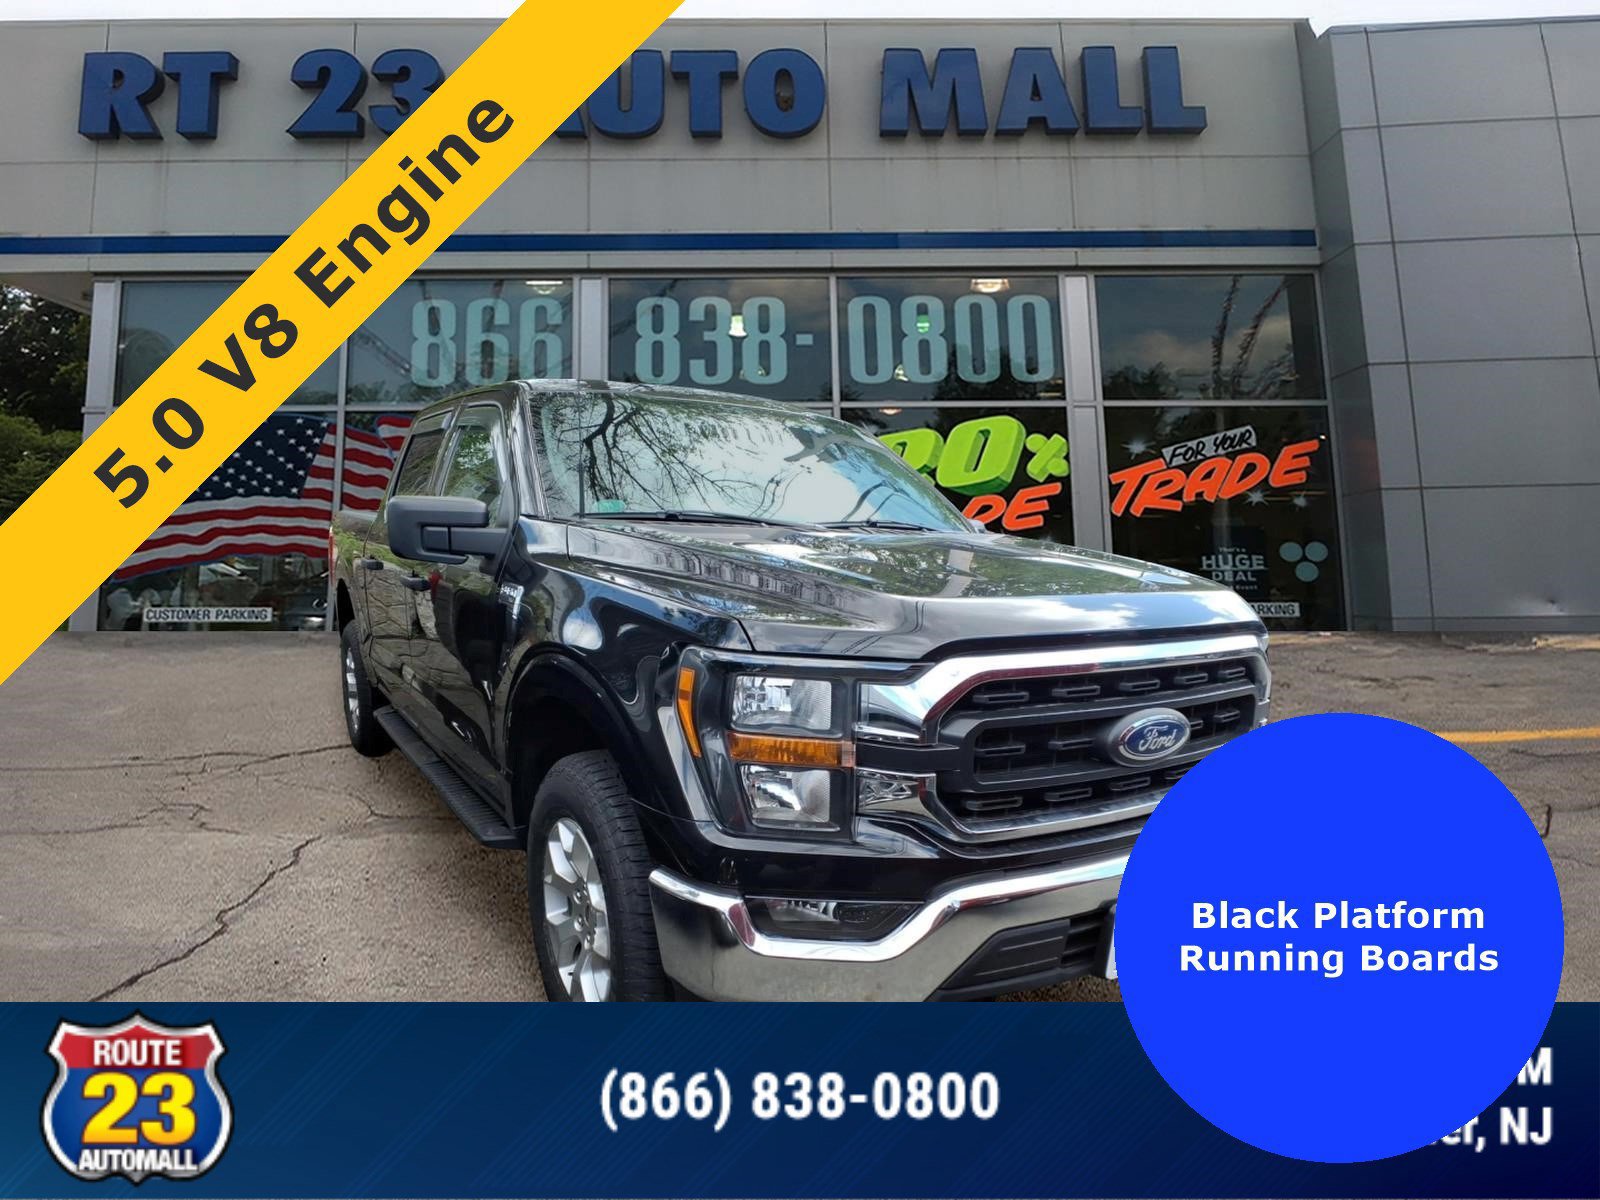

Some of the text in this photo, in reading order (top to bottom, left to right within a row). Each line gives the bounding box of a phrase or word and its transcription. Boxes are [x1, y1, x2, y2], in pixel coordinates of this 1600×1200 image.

[78, 46, 1207, 140] RT 23 UTO MALL
[410, 297, 565, 390] 866
[847, 295, 1055, 384] 0800
[1168, 429, 1252, 466] FOR YOUR
[1109, 439, 1320, 518] TRADE
[1201, 554, 1265, 569] HUGE
[1211, 571, 1257, 582] DEAL
[145, 608, 268, 621] CUSTOMER PARKING
[1250, 603, 1296, 616] RKING
[1138, 724, 1178, 752] Ford
